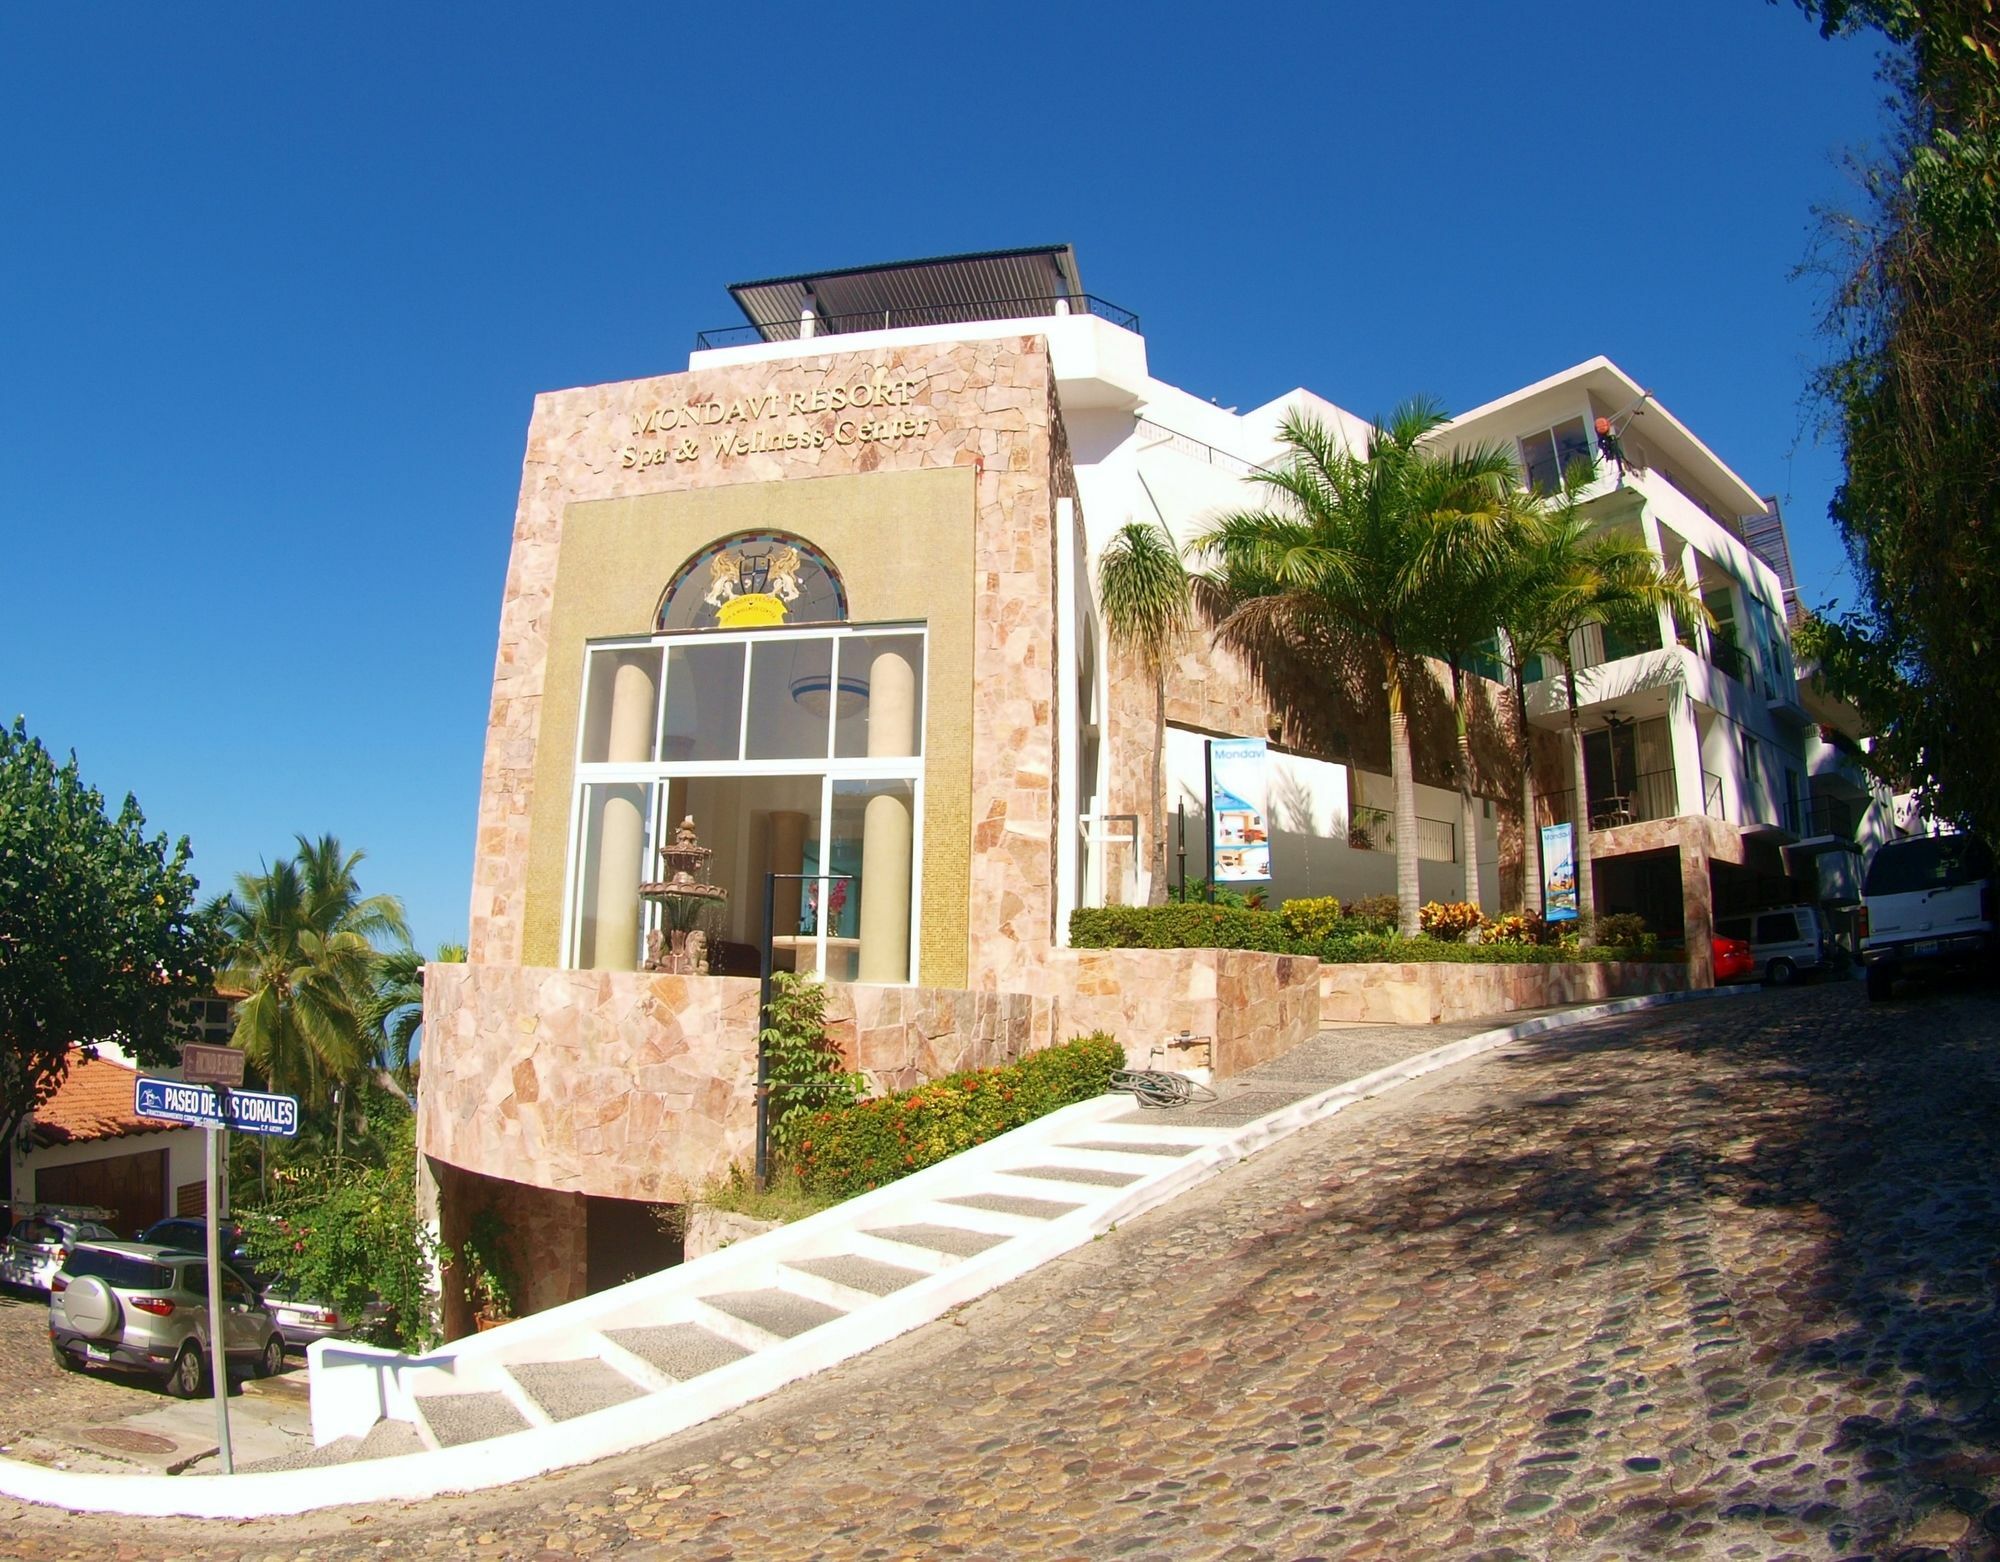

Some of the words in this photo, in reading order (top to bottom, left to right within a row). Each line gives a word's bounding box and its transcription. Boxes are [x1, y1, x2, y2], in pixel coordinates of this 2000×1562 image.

[632, 395, 780, 435] MONDAVI
[788, 380, 915, 416] RESORT
[622, 443, 666, 472] Spa
[675, 437, 698, 462] &
[709, 427, 825, 458] Wellness
[835, 417, 929, 447] Center
[1214, 749, 1265, 760] Mondavi
[165, 1087, 198, 1114] PASEO
[201, 1092, 216, 1116] DE
[242, 1098, 292, 1126] CORALES
